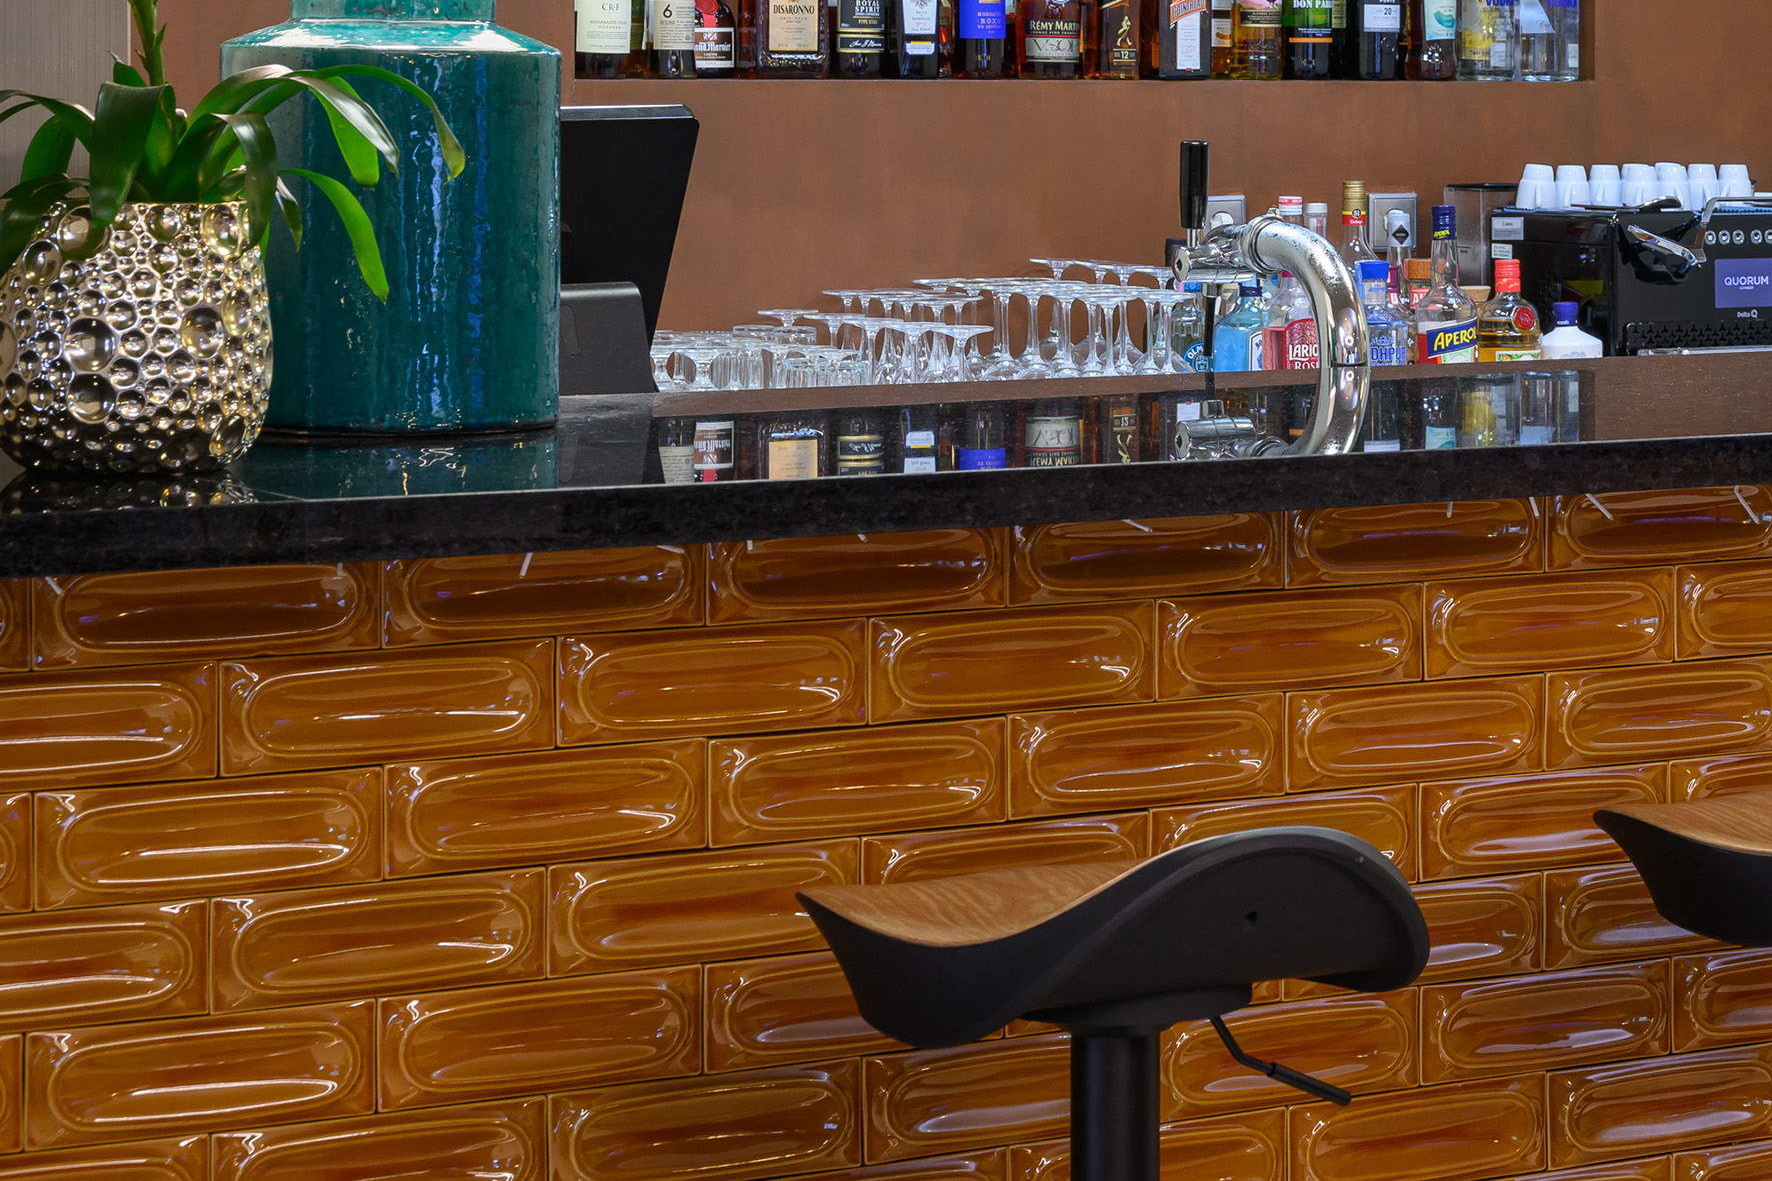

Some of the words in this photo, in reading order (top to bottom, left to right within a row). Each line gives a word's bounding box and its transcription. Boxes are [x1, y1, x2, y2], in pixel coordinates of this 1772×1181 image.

[773, 4, 815, 15] DISARONNO
[1293, 0, 1313, 9] DON
[662, 3, 673, 18] 6
[1384, 7, 1392, 16] 20
[1030, 19, 1054, 30] RÉMY
[1120, 50, 1129, 59] 12
[1724, 275, 1769, 286] QUORUM
[1750, 309, 1758, 318] Q
[1434, 325, 1477, 352] APEROL
[1288, 344, 1318, 361] LARIO
[1371, 346, 1407, 360] DHPUR
